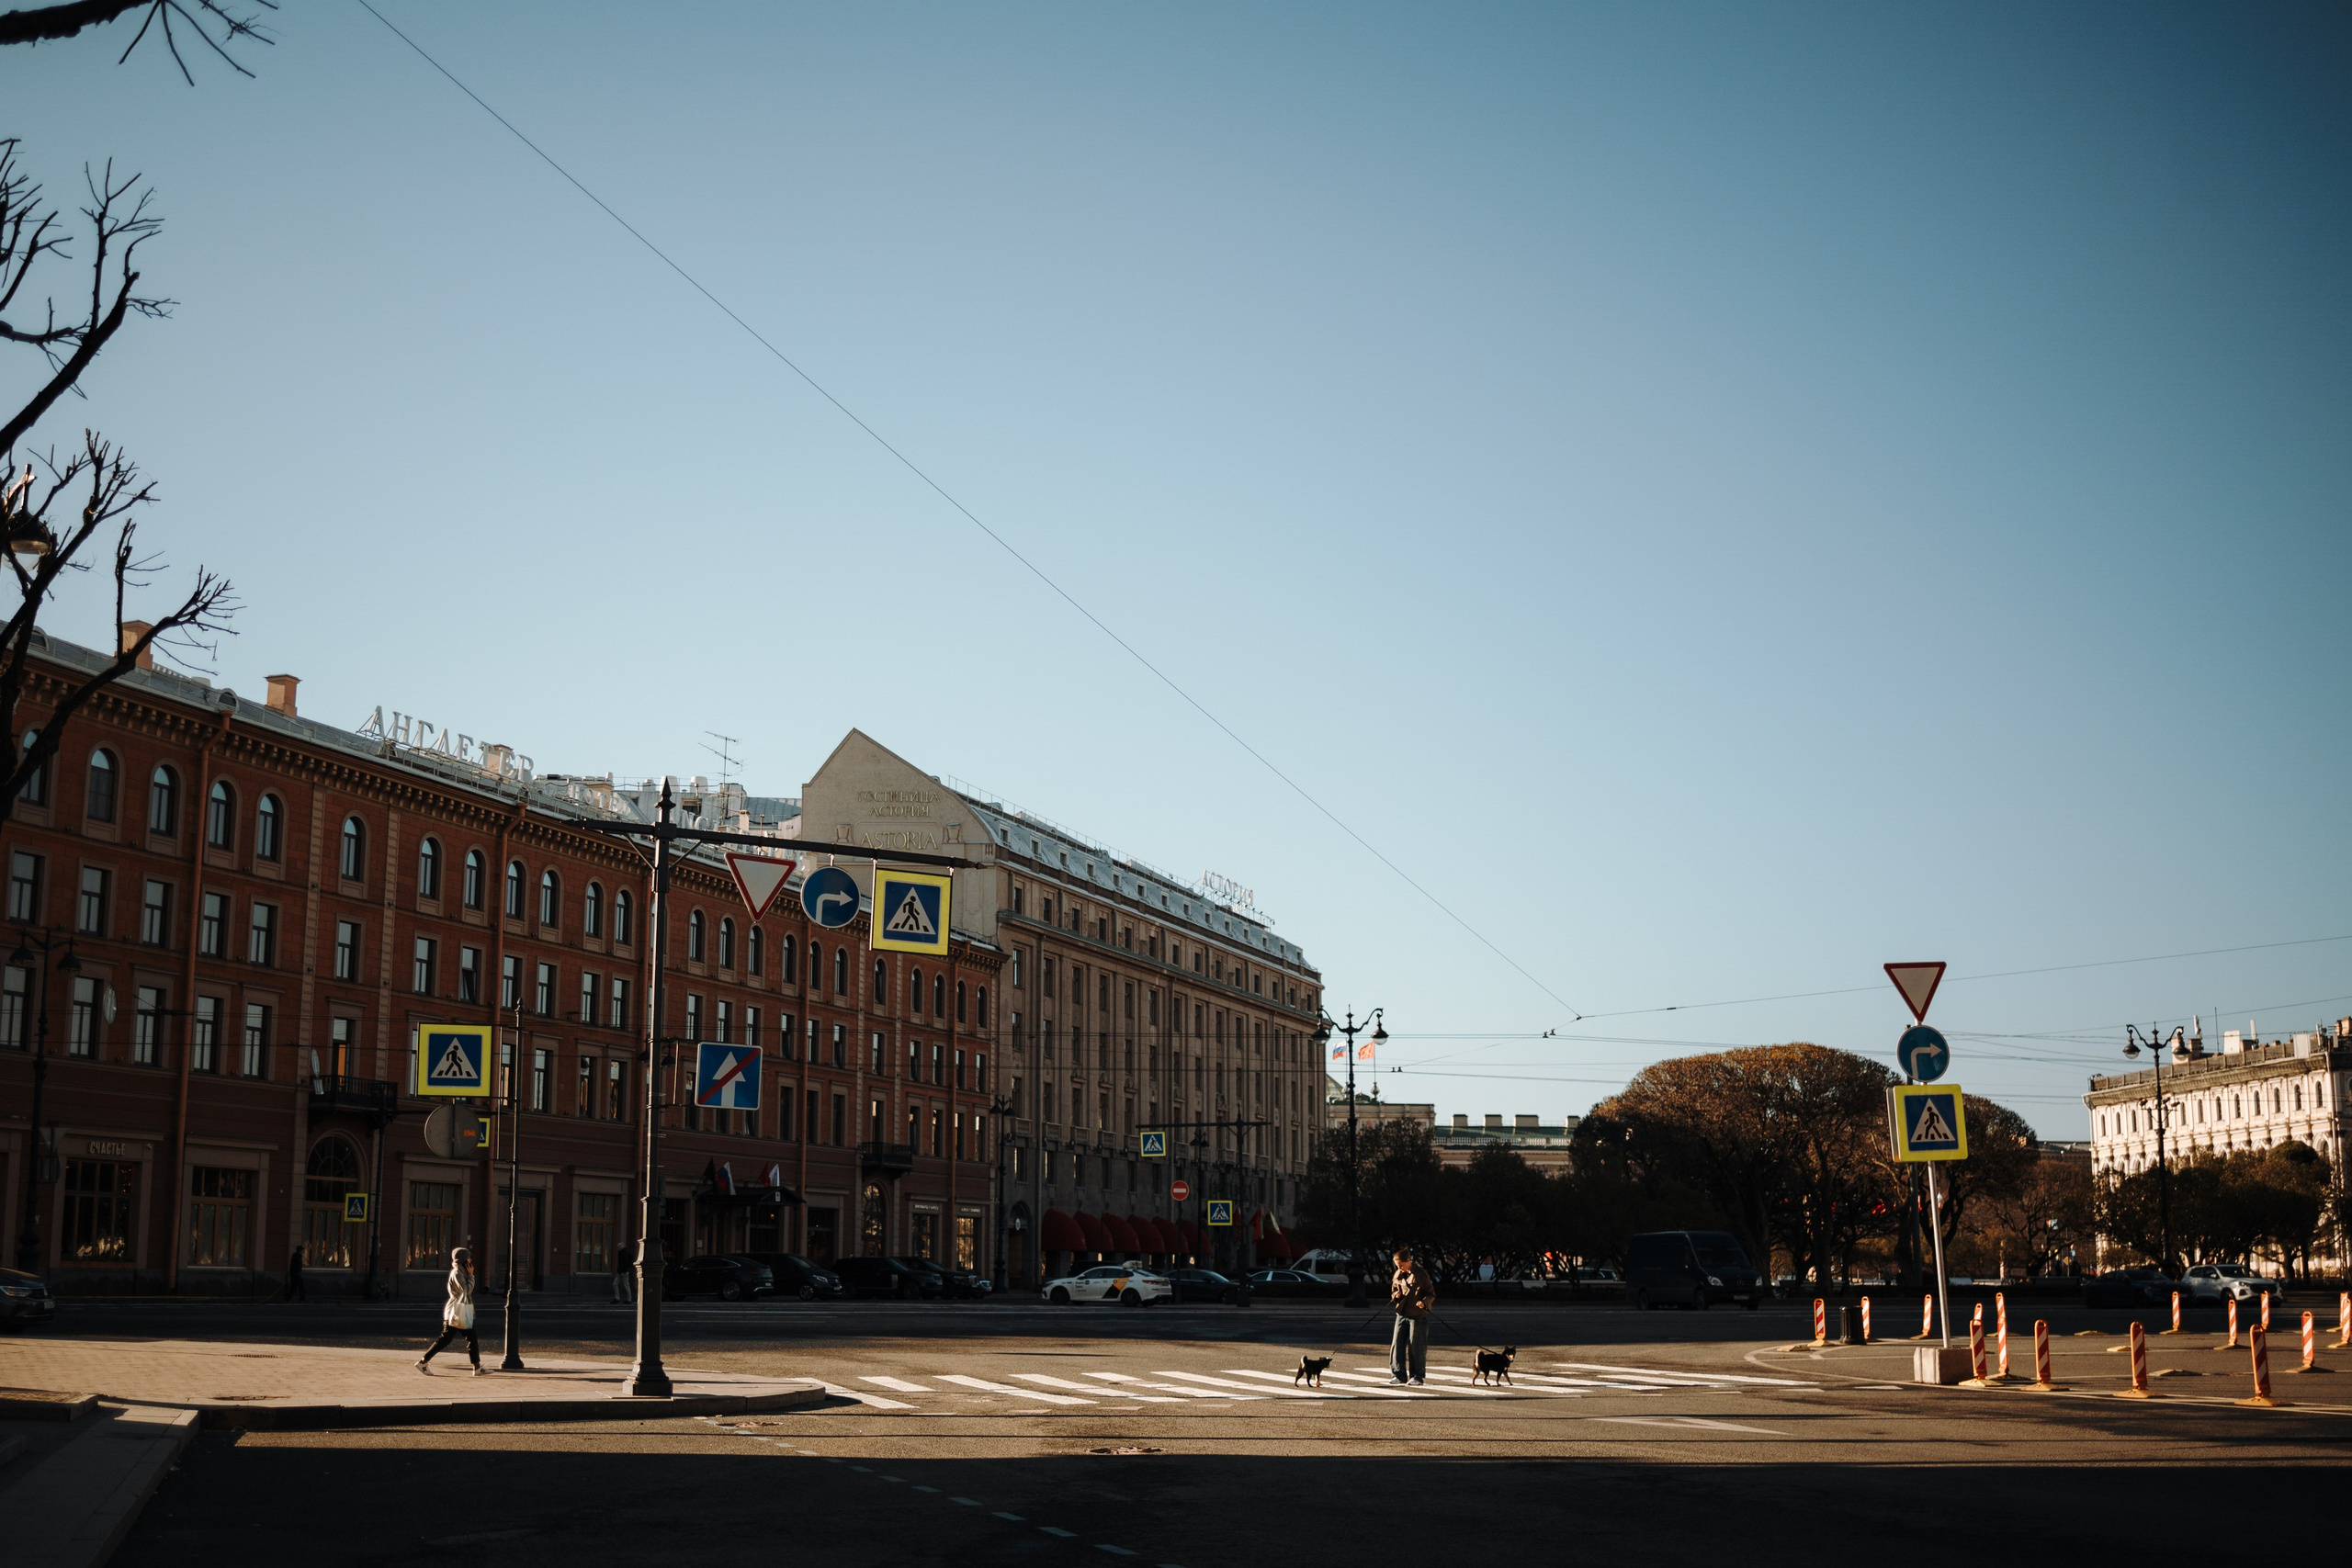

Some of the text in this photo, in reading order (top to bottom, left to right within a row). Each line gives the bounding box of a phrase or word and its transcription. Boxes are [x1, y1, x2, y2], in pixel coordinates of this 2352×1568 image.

[857, 791, 941, 804] ГОСТИНИЦА
[869, 806, 930, 818] АСТОРИЯ
[860, 831, 939, 850] ASTORIA
[1202, 868, 1253, 907] АСТОРИЯ
[90, 1141, 125, 1156] СЧАСТЬЕ
